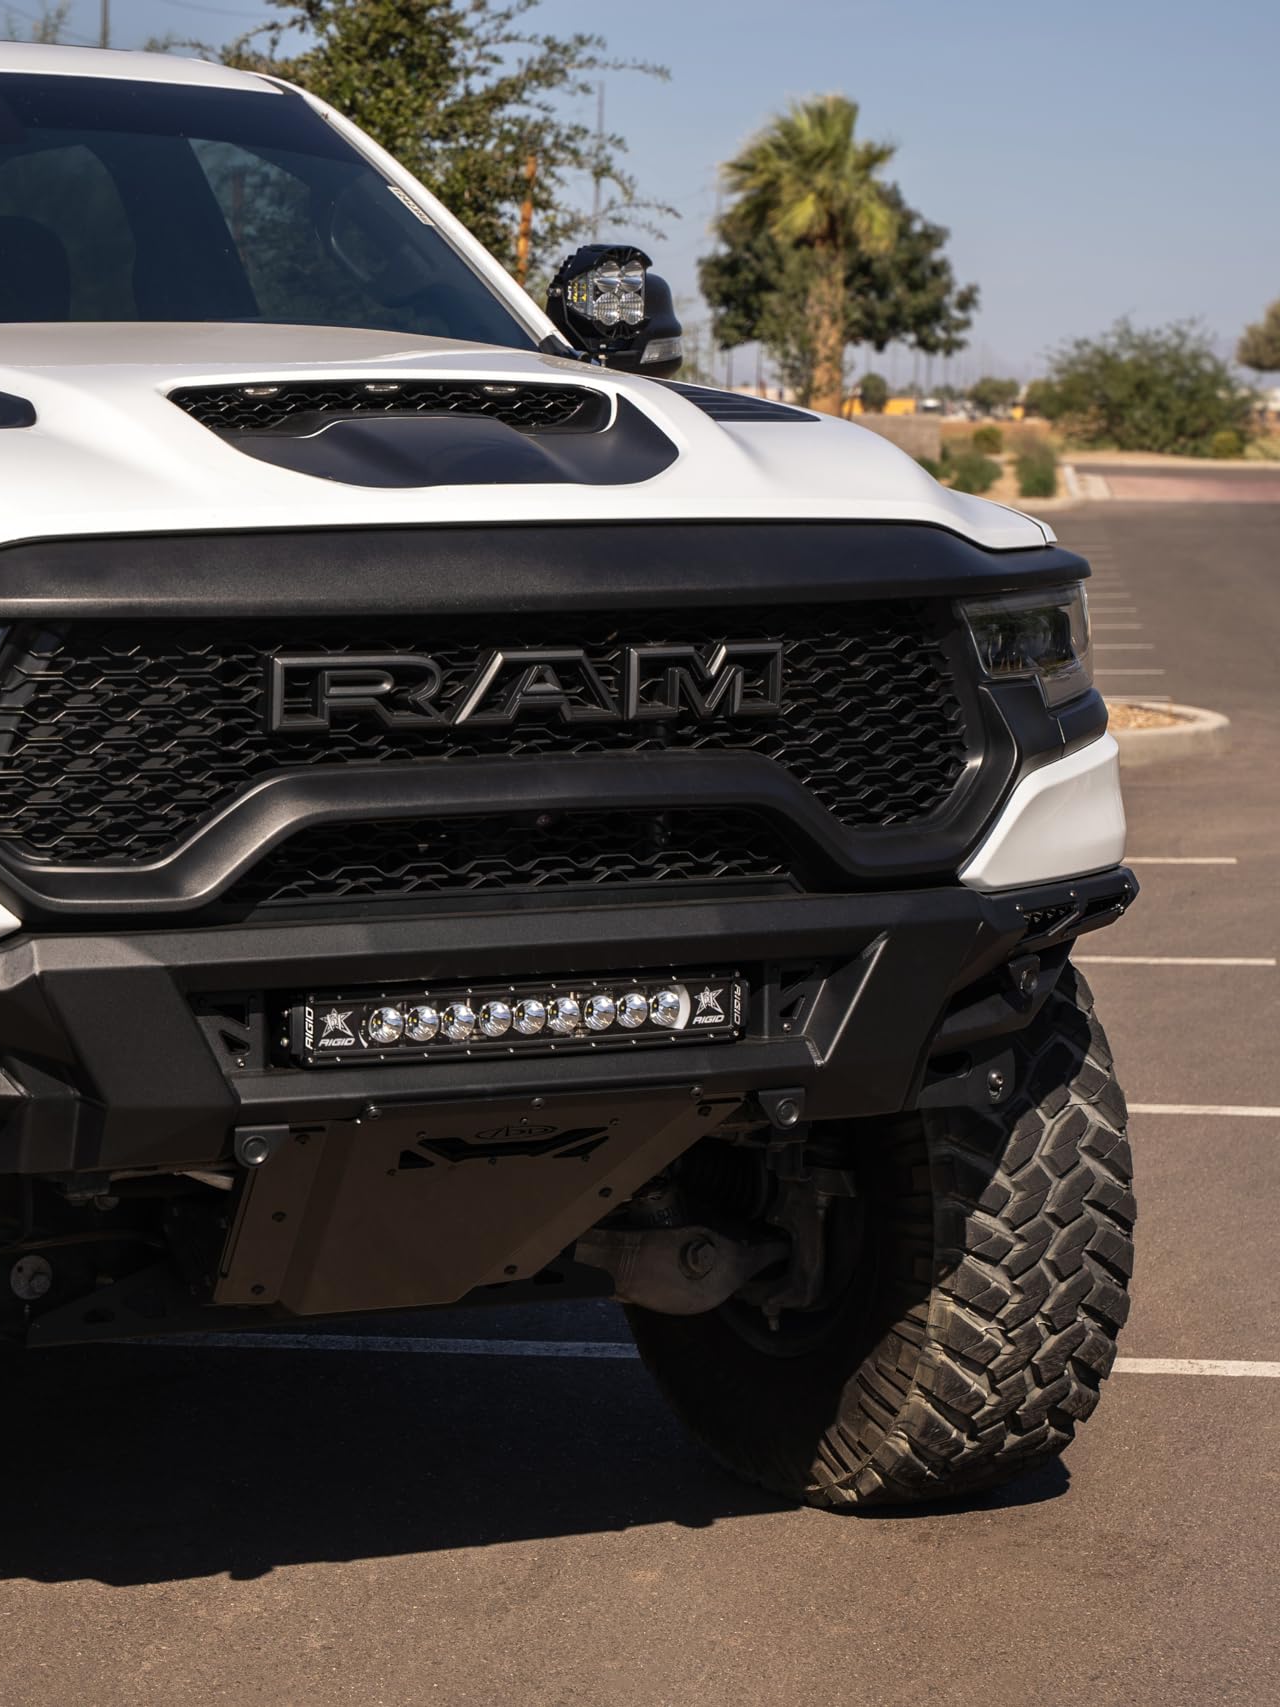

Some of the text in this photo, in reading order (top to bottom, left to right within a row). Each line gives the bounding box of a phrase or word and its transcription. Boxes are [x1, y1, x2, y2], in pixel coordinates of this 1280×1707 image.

[267, 641, 784, 732] RAM
[305, 1006, 314, 1050] RIGID
[692, 1015, 725, 1025] RIGID
[318, 1037, 355, 1048] RIGID
